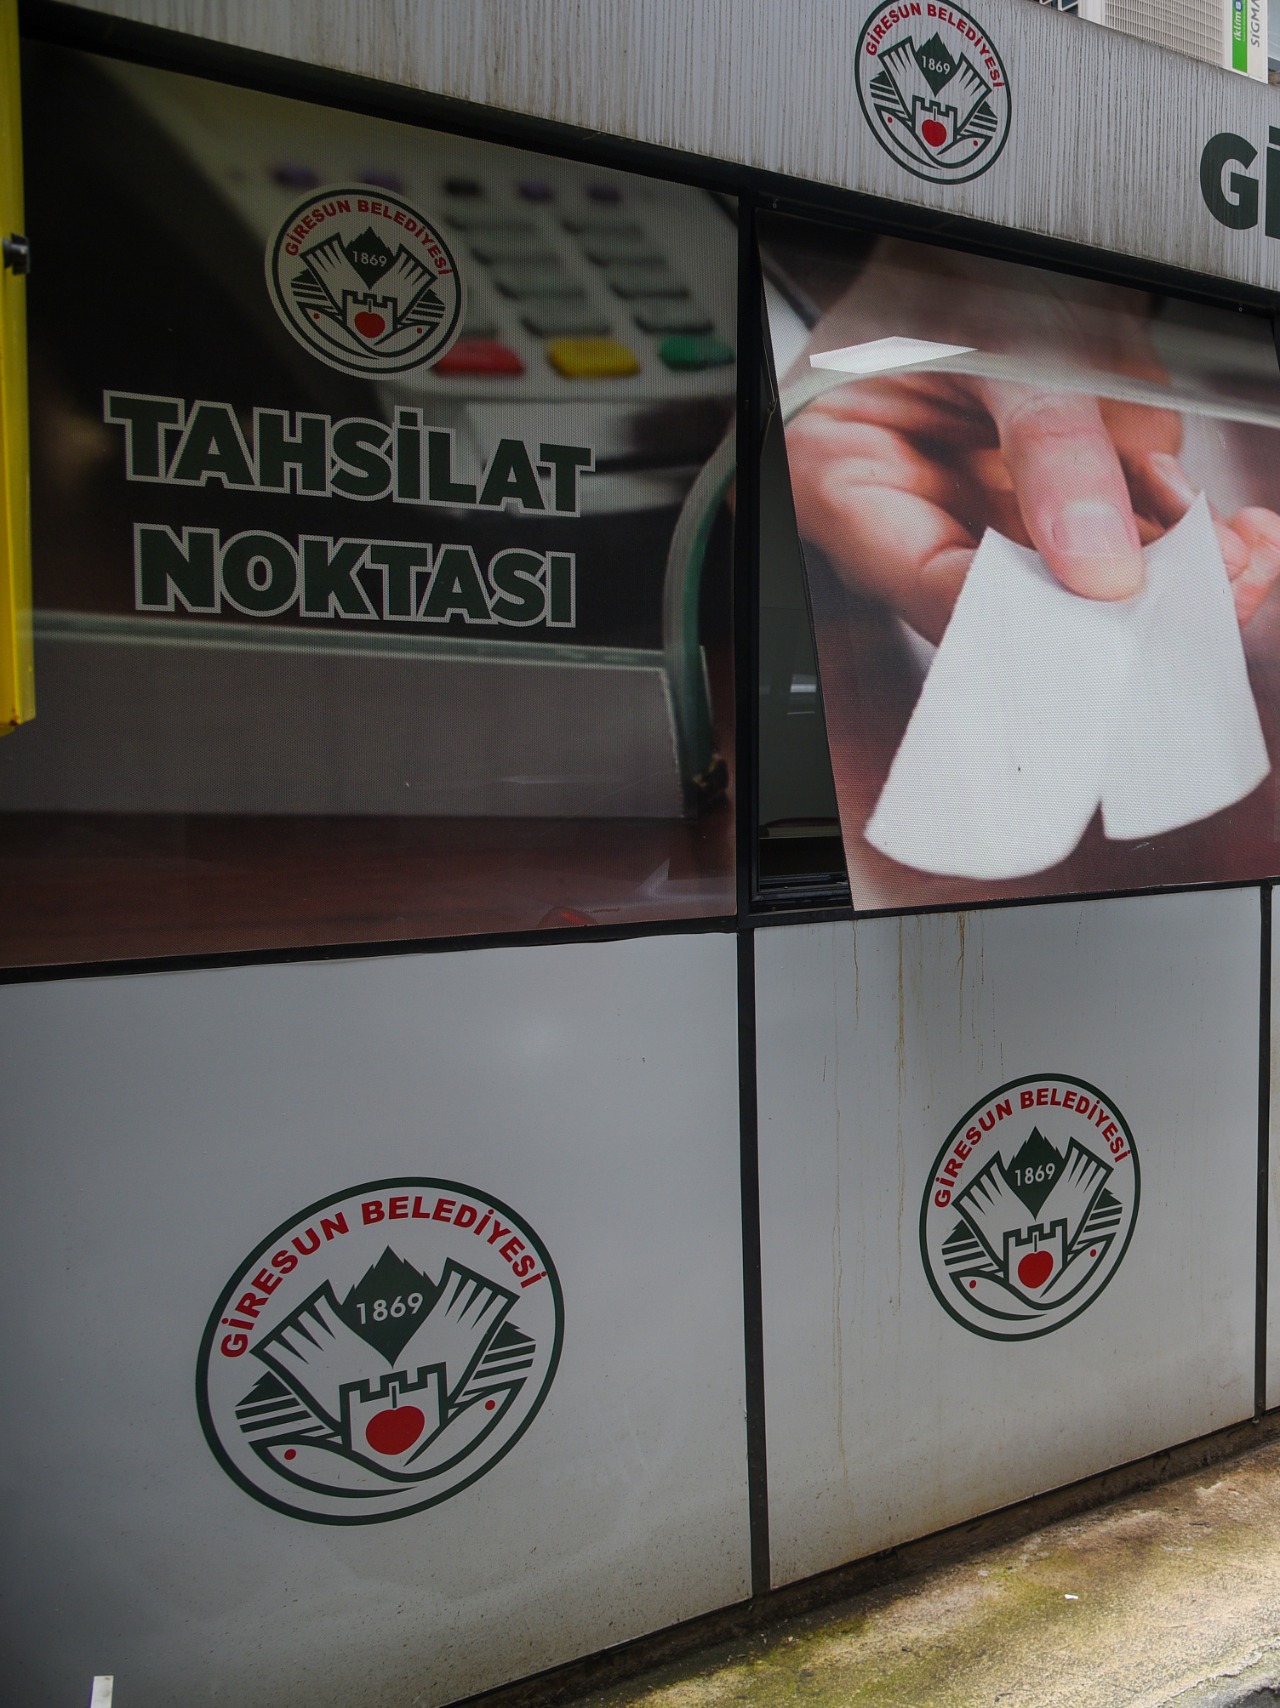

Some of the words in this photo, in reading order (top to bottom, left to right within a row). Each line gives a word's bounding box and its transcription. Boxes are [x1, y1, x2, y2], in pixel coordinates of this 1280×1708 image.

[866, 3, 922, 56] GİRESUN
[927, 3, 1005, 88] BELEDİYESİ
[922, 56, 950, 75] 1869
[285, 200, 351, 256] GİRESUN
[357, 199, 452, 275] BELEDİYESİ
[353, 250, 388, 267] 1869
[103, 389, 596, 518] TAHSİLAT
[133, 522, 577, 628] NOKTASI
[934, 1099, 1013, 1208] GİRESUN
[1020, 1088, 1131, 1163] BELEDİYESİ
[1014, 1163, 1056, 1187] 1869
[220, 1211, 350, 1358] GİRESUN
[361, 1196, 548, 1289] BELEDİYESİ
[356, 1292, 424, 1325] 1869
